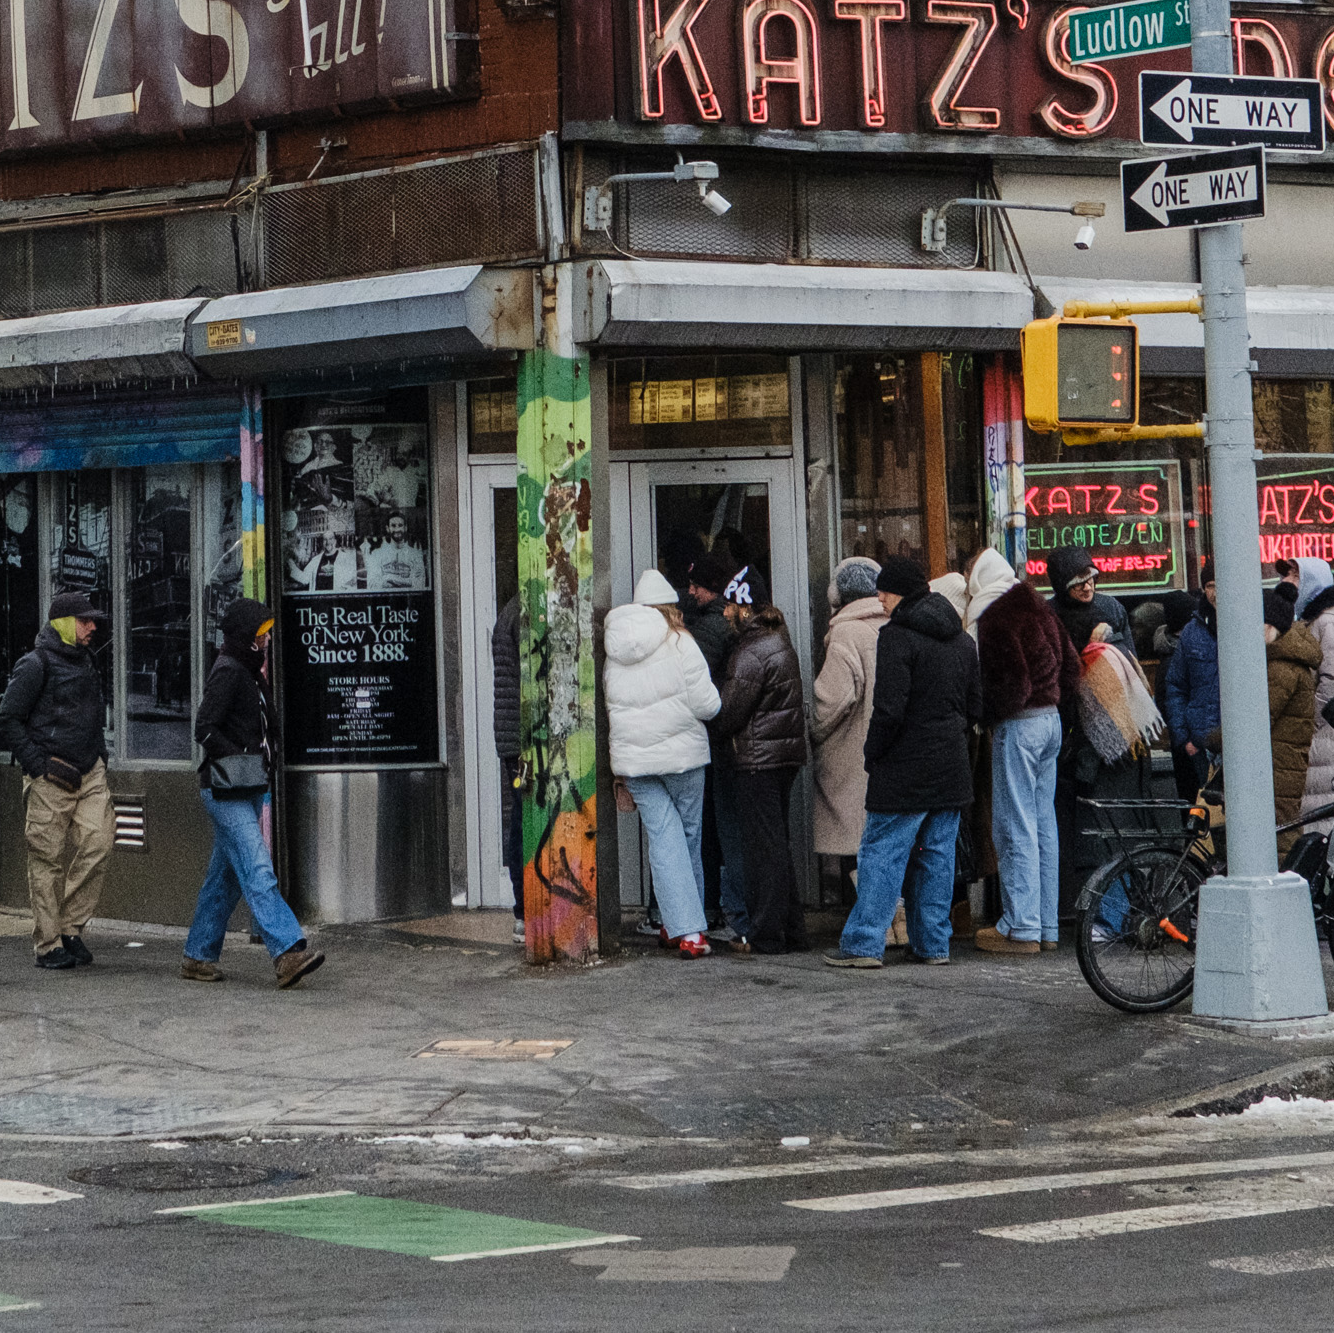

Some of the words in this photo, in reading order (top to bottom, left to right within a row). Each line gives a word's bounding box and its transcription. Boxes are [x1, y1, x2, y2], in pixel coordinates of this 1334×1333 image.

[1074, 8, 1165, 57] Ludlow
[1175, 0, 1190, 26] St
[1170, 96, 1220, 125] ONE
[1245, 100, 1298, 128] WAY
[1151, 178, 1190, 208] ONE
[1209, 170, 1249, 201] WAY
[1027, 521, 1164, 550] ELICATESSEN
[296, 607, 328, 626] The
[332, 605, 373, 625] Real
[376, 605, 419, 624] Taste
[301, 625, 322, 645] of
[322, 625, 366, 645] New
[369, 623, 414, 643] York.
[308, 645, 357, 664] Since
[363, 643, 409, 663] 1888.
[329, 676, 358, 686] STORE
[359, 675, 390, 684] HOURS
